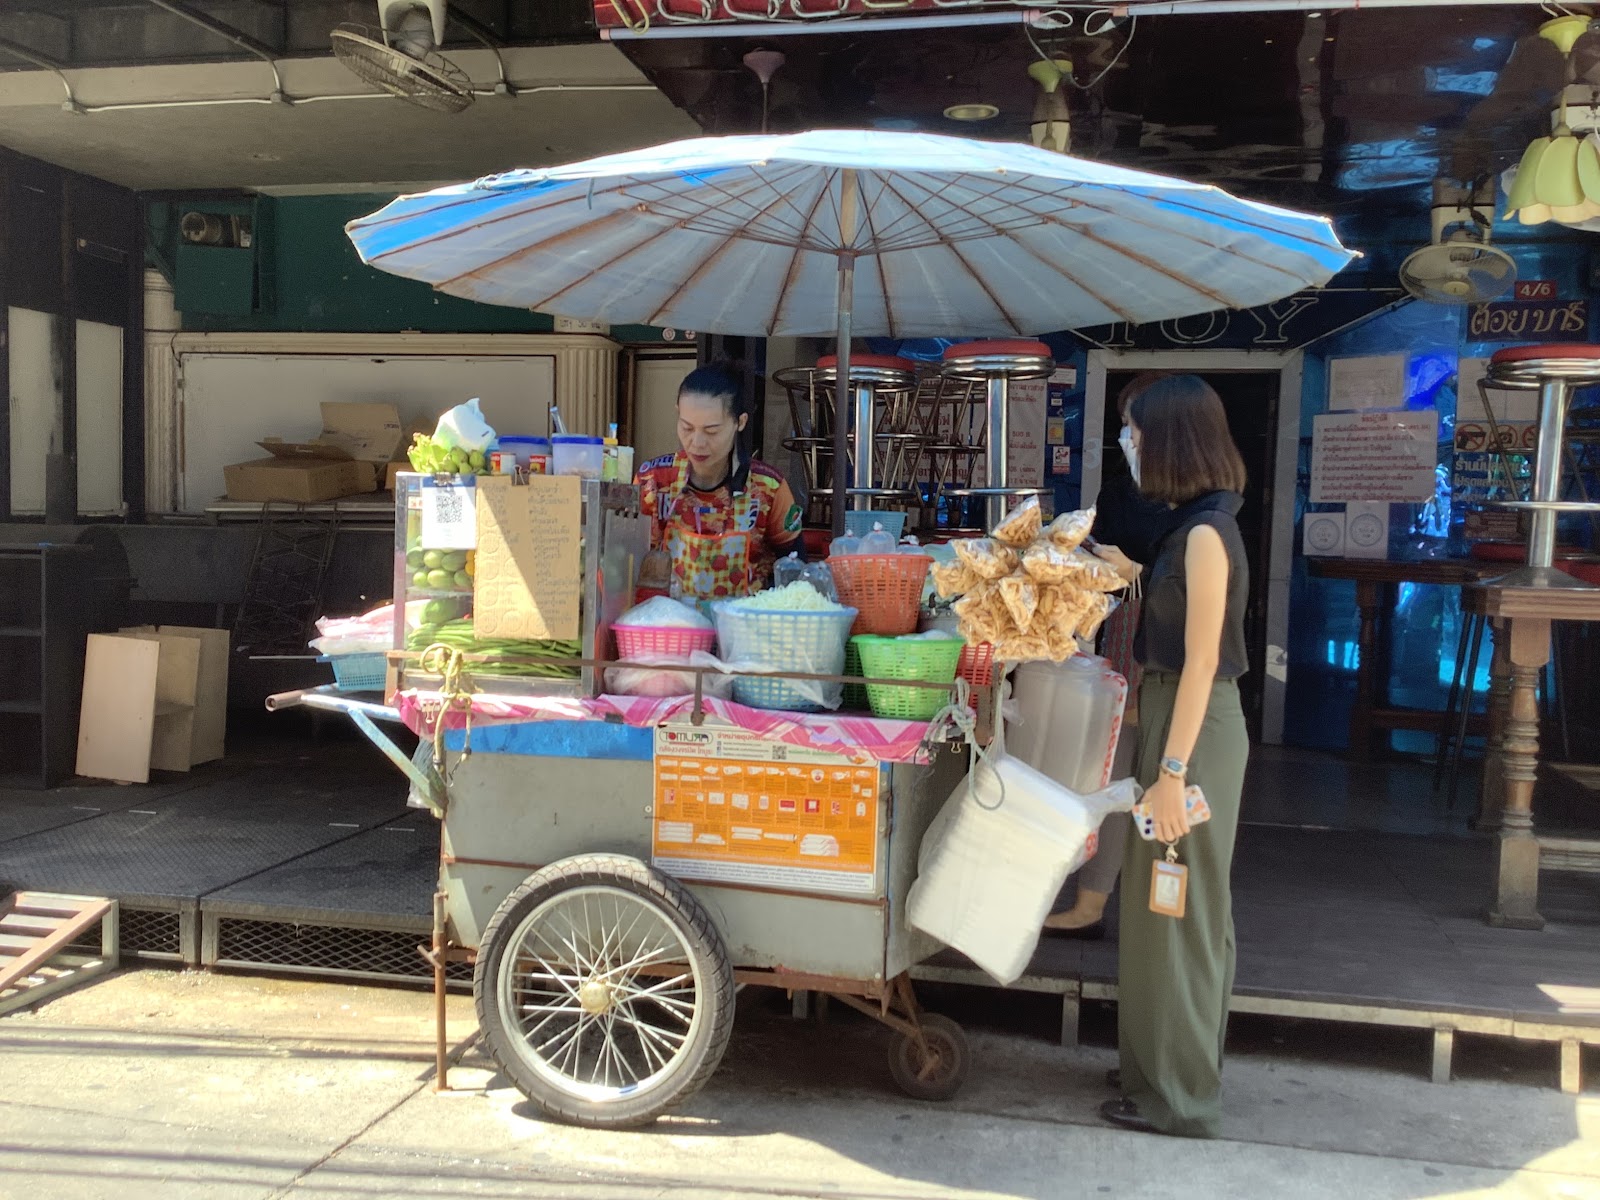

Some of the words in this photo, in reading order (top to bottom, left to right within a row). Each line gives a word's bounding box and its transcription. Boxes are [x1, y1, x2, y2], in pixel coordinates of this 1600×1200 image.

[1520, 281, 1552, 297] 4/6
[1470, 303, 1529, 335] ต้อย
[1533, 300, 1586, 333] บาร์
